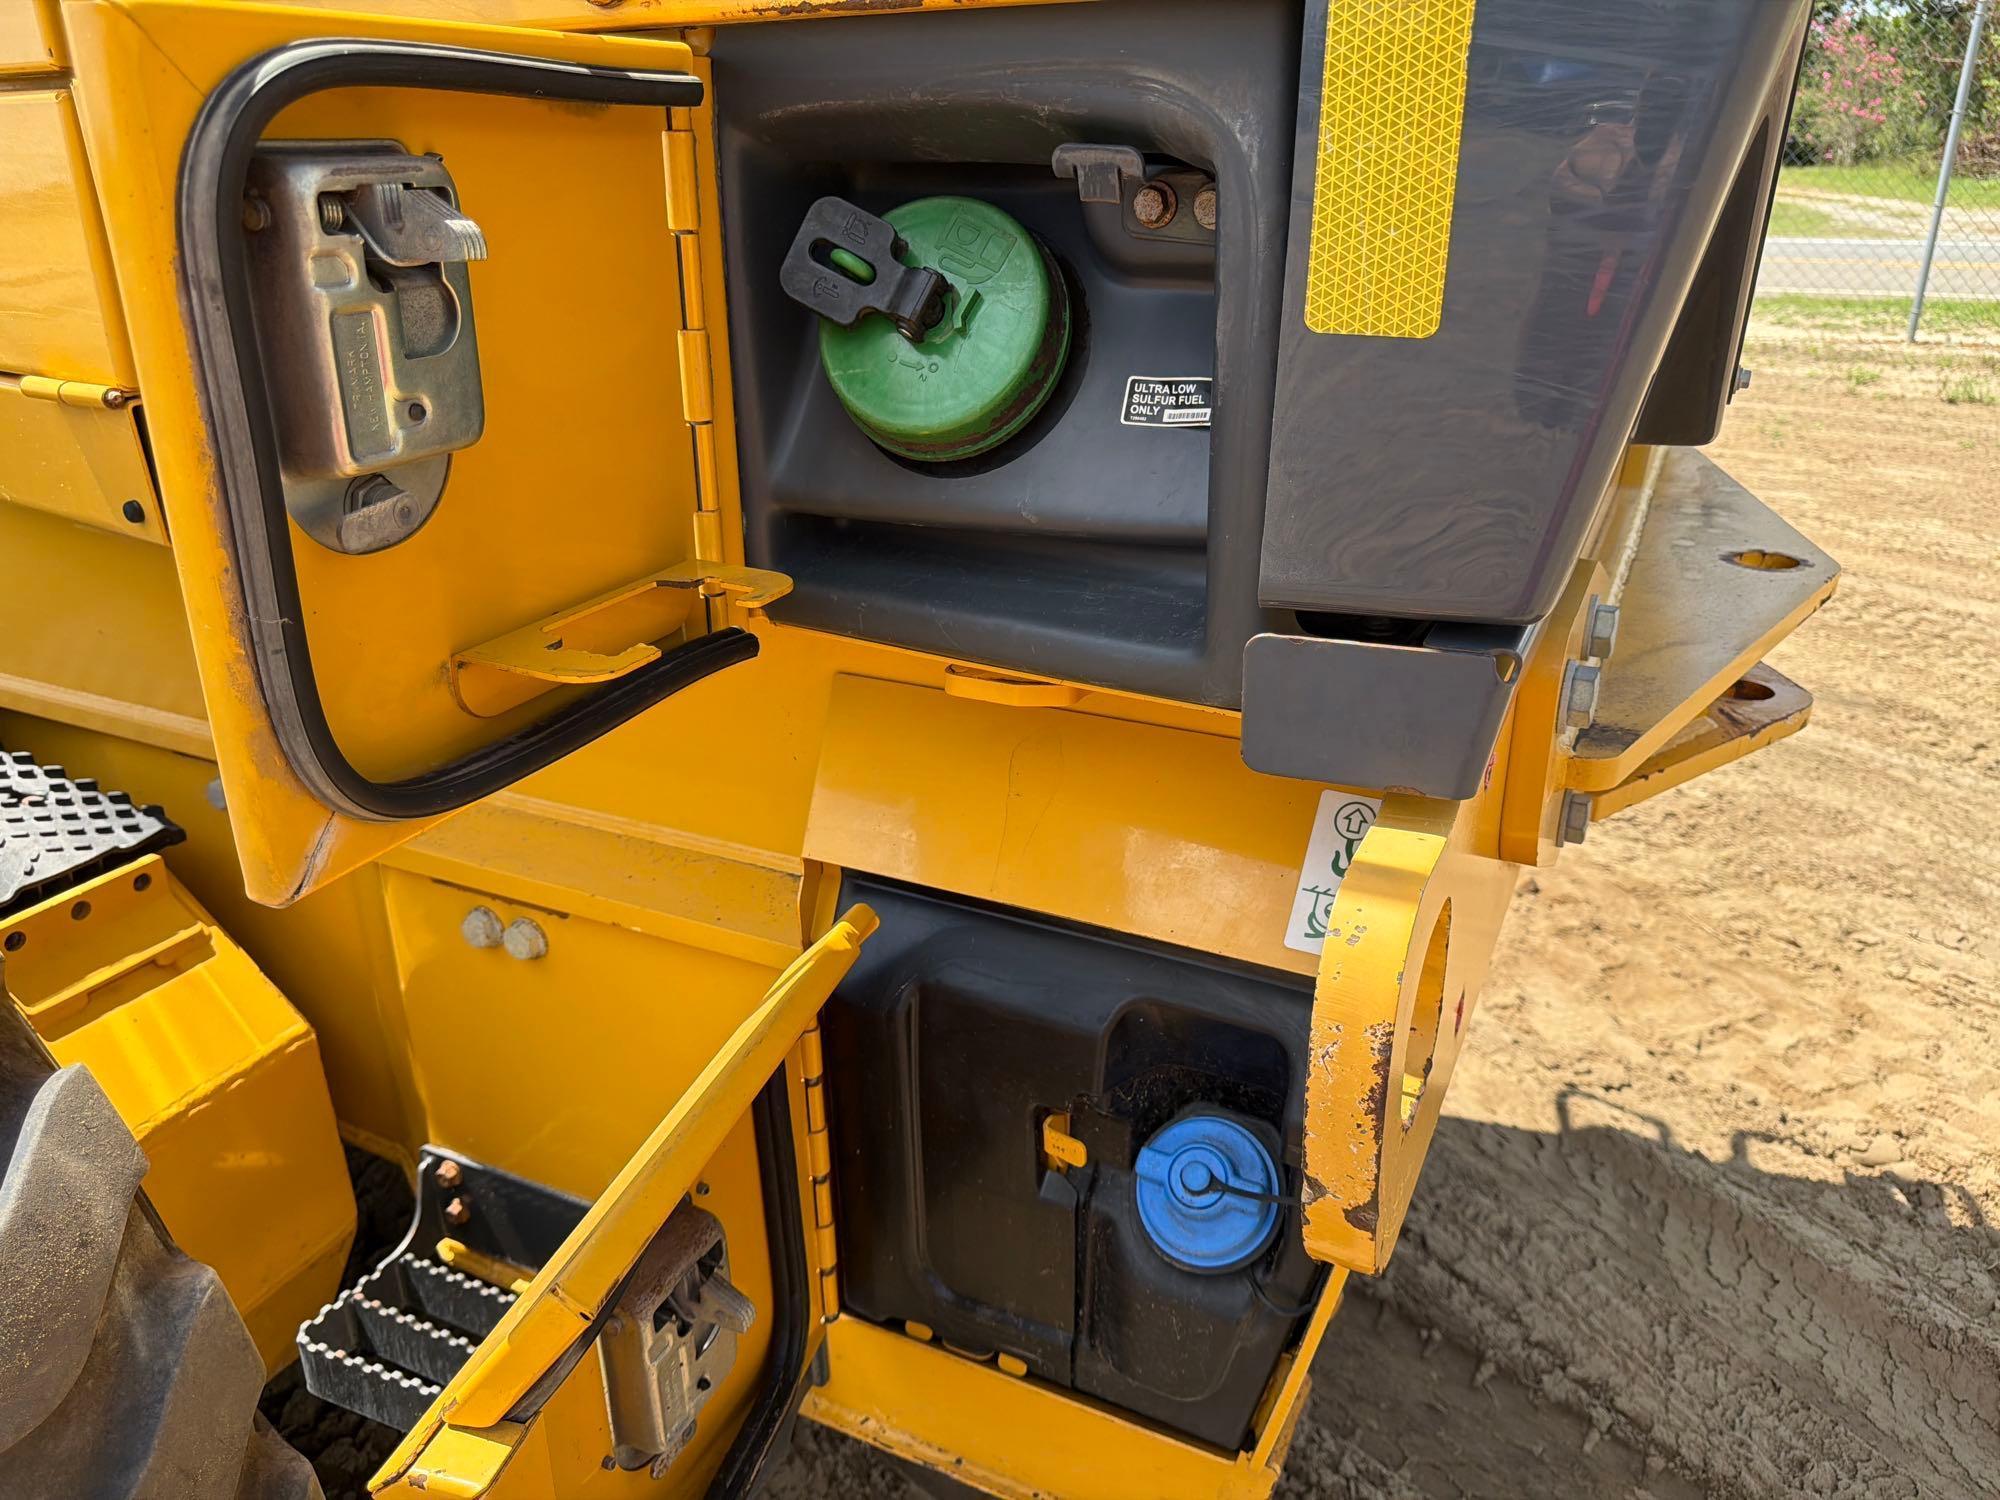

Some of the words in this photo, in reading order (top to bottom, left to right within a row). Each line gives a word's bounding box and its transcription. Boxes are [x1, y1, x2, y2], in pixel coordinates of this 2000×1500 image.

[359, 343, 376, 402] HAMPTON
[1134, 383, 1170, 394] ULTRA
[1172, 383, 1197, 394] LOW
[1132, 394, 1177, 405] SULFUR
[1178, 394, 1205, 405] FUEL
[1130, 405, 1160, 416] ONLY
